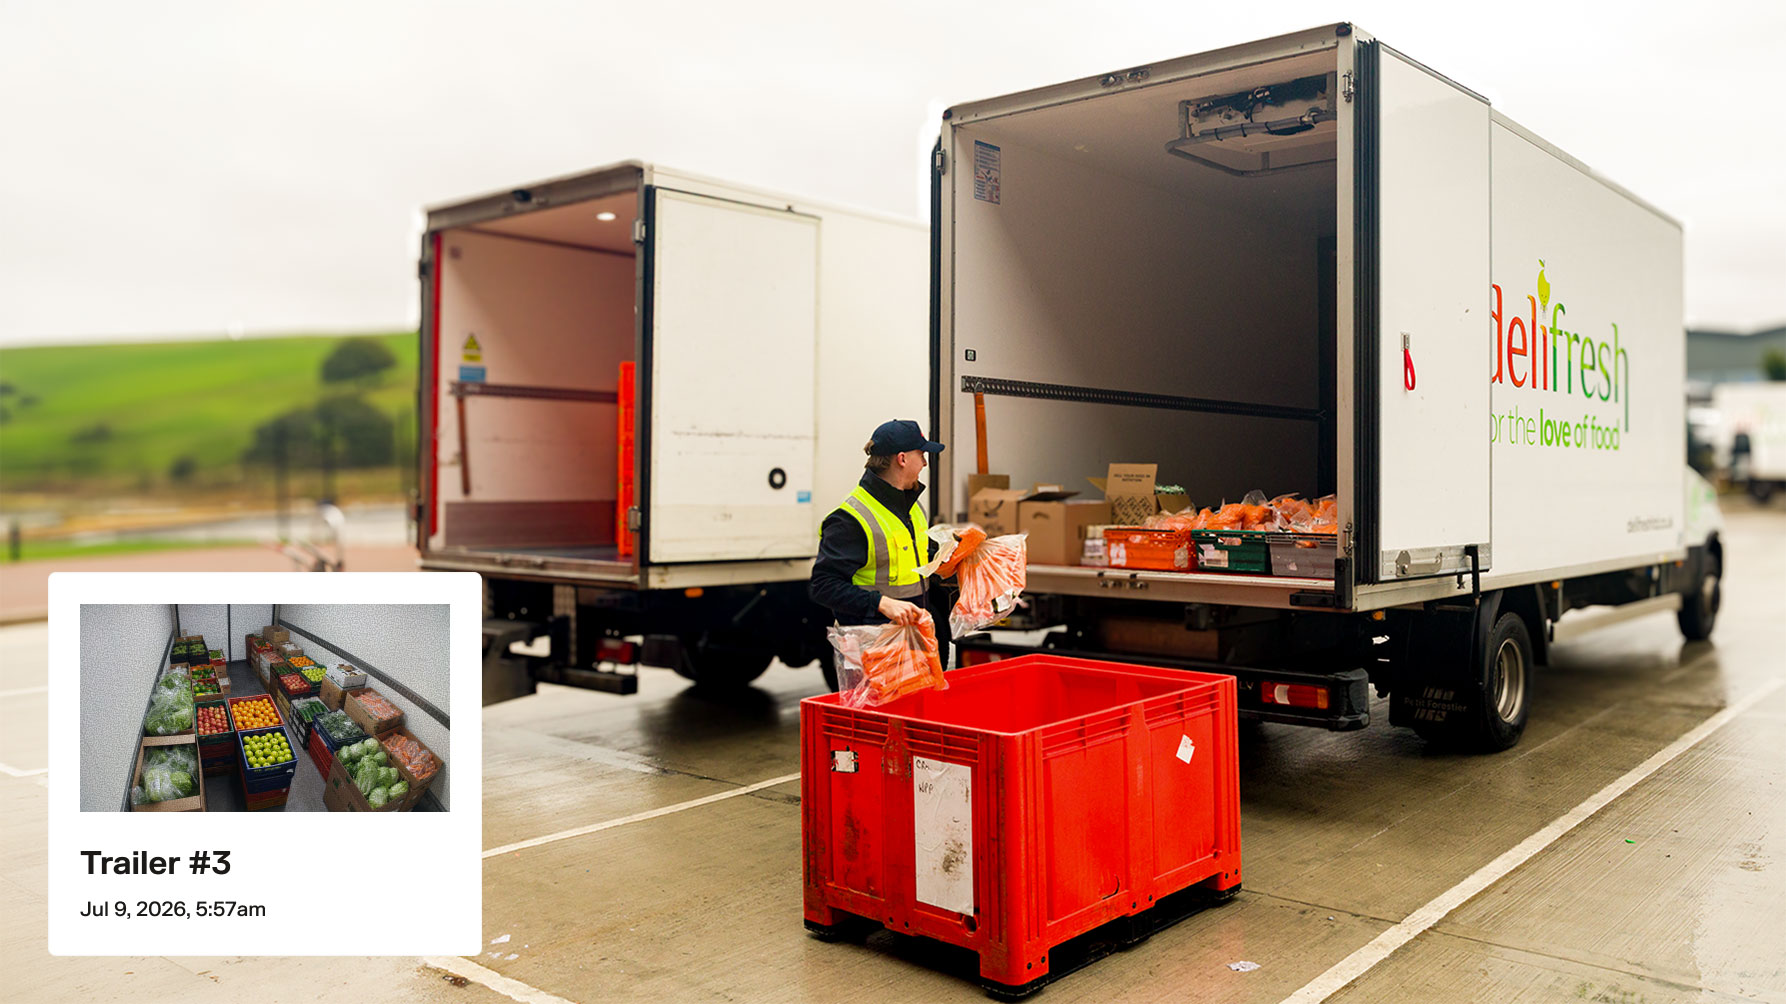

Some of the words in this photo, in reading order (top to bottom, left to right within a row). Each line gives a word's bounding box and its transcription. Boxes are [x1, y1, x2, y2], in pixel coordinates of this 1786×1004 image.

[1508, 405, 1536, 446] the
[1540, 408, 1571, 447] love
[1574, 414, 1588, 448] of
[1591, 415, 1620, 451] food
[1427, 700, 1467, 712] Forestier
